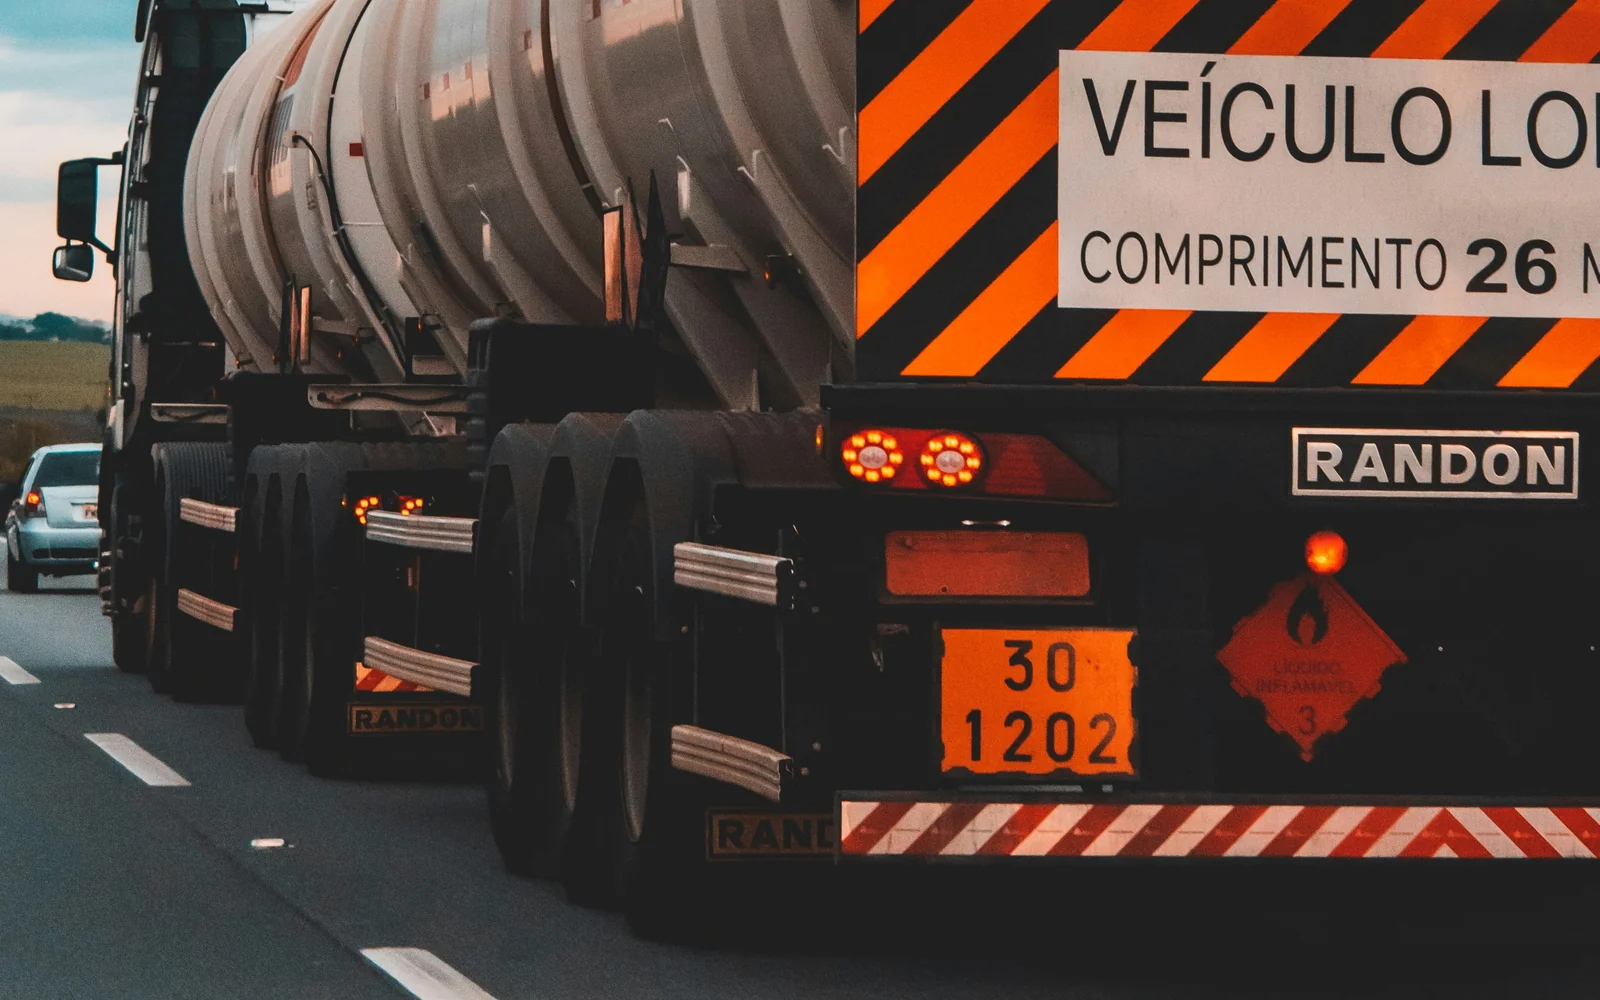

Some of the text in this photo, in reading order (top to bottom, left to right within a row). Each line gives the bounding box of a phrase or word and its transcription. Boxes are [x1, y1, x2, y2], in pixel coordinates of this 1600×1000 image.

[1082, 61, 1600, 170] VEÍCULO LO
[1080, 230, 1447, 291] COMPRIMENTO
[1465, 238, 1557, 294] 26
[1306, 441, 1566, 486] RANDON
[1004, 639, 1076, 692] 30
[355, 708, 481, 729] RANDON
[966, 709, 1117, 764] 1202
[1298, 705, 1316, 735] 3
